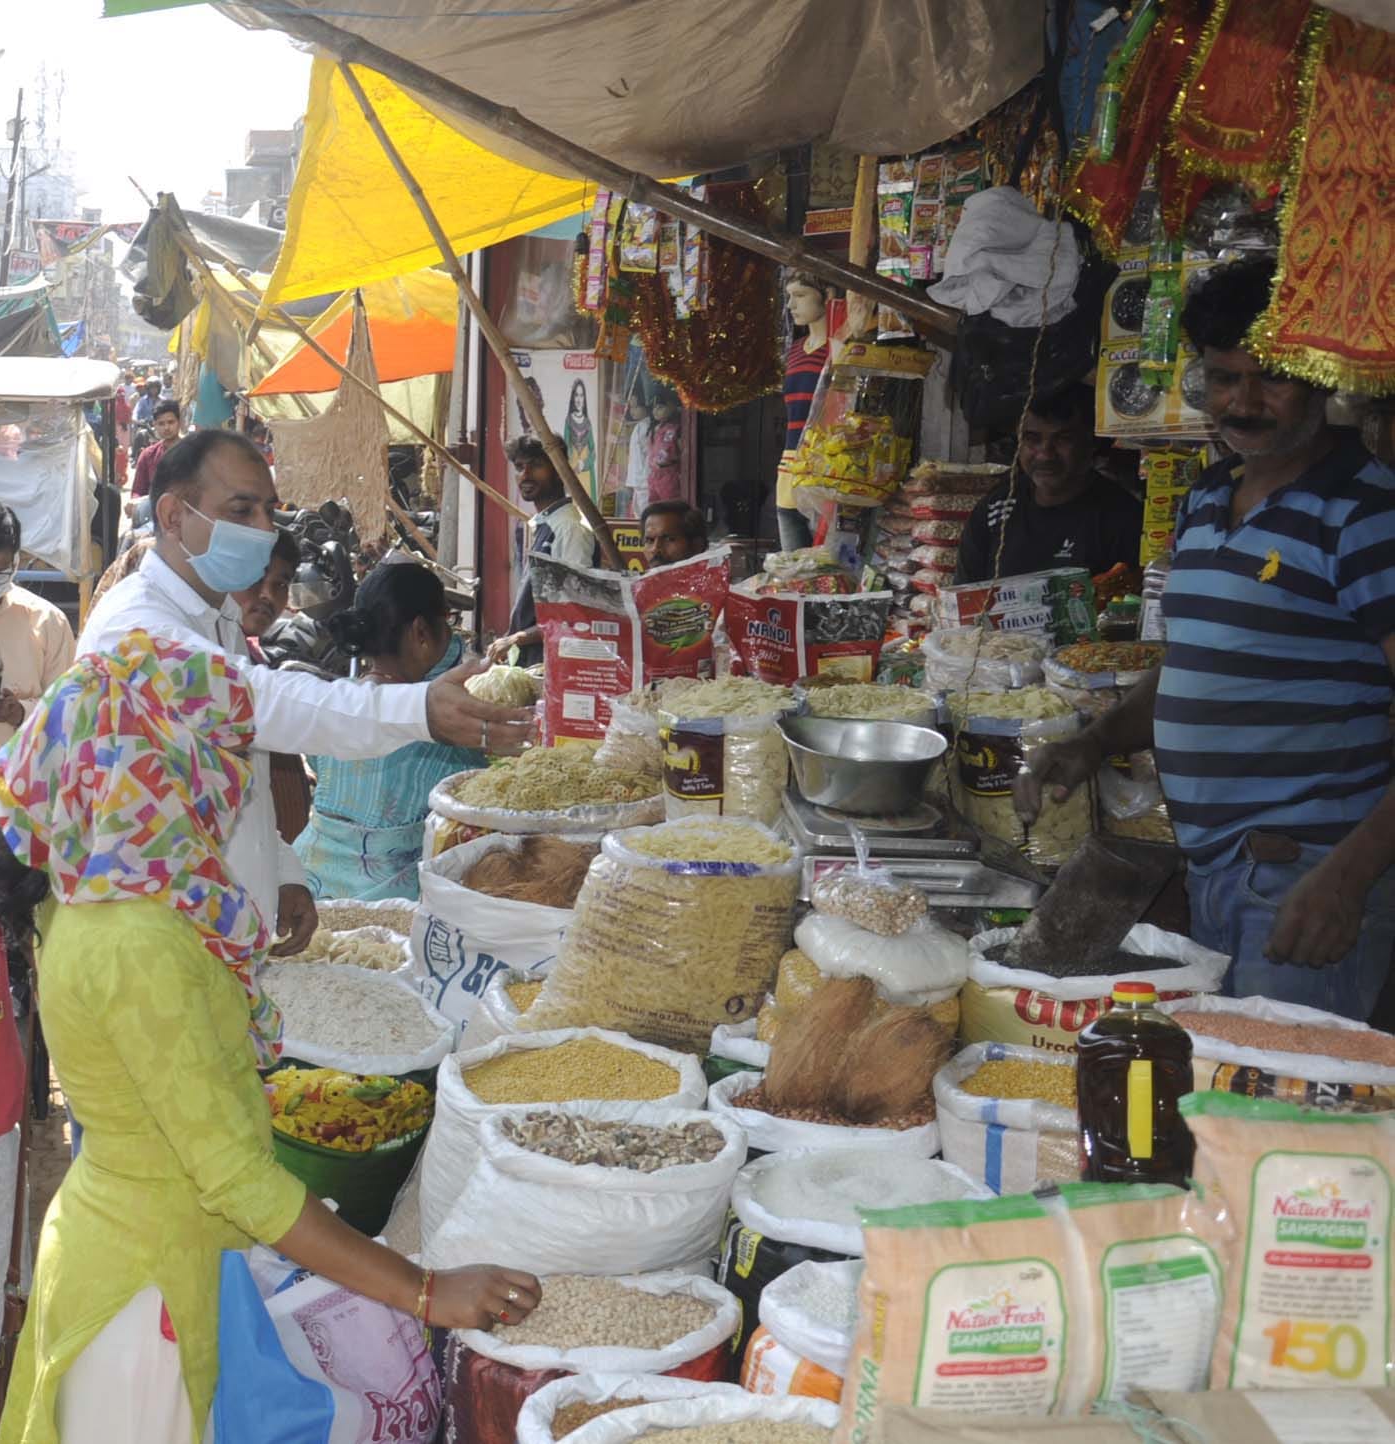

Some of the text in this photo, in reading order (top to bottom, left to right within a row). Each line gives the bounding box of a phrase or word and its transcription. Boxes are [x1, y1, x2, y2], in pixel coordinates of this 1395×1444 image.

[748, 622, 791, 645] NANDI
[1000, 612, 1054, 632] TIRANGA
[1272, 1194, 1372, 1219] Nature Fresh
[1279, 1221, 1366, 1236] SAMPOORNA
[947, 1304, 1045, 1330] Nature Fresh
[952, 1329, 1041, 1347] SAMPOORNA
[1262, 1319, 1369, 1380] 150
